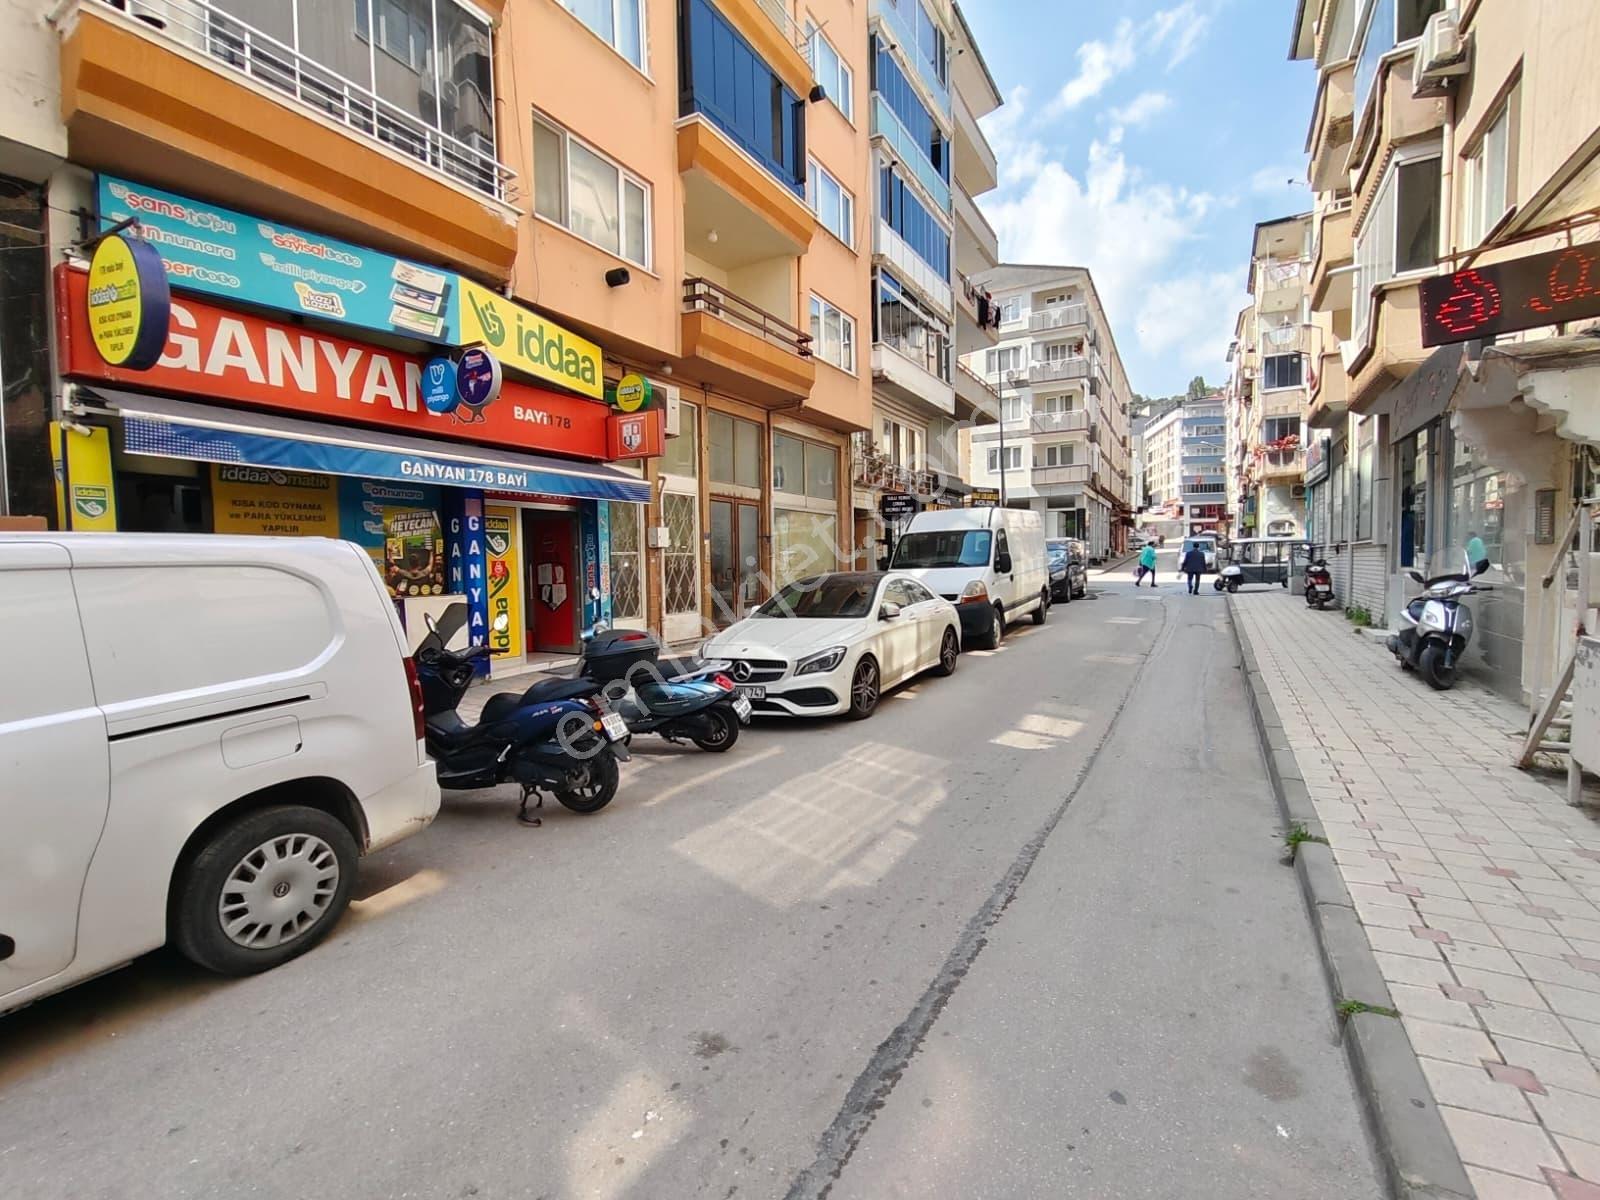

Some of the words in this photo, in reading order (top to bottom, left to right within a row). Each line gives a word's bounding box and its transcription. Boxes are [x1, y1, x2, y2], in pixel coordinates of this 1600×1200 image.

[516, 313, 597, 387] iddaa
[222, 465, 270, 482] iddaa
[400, 460, 465, 480] GANYAN
[468, 468, 494, 484] 178
[486, 519, 508, 529] ddaa
